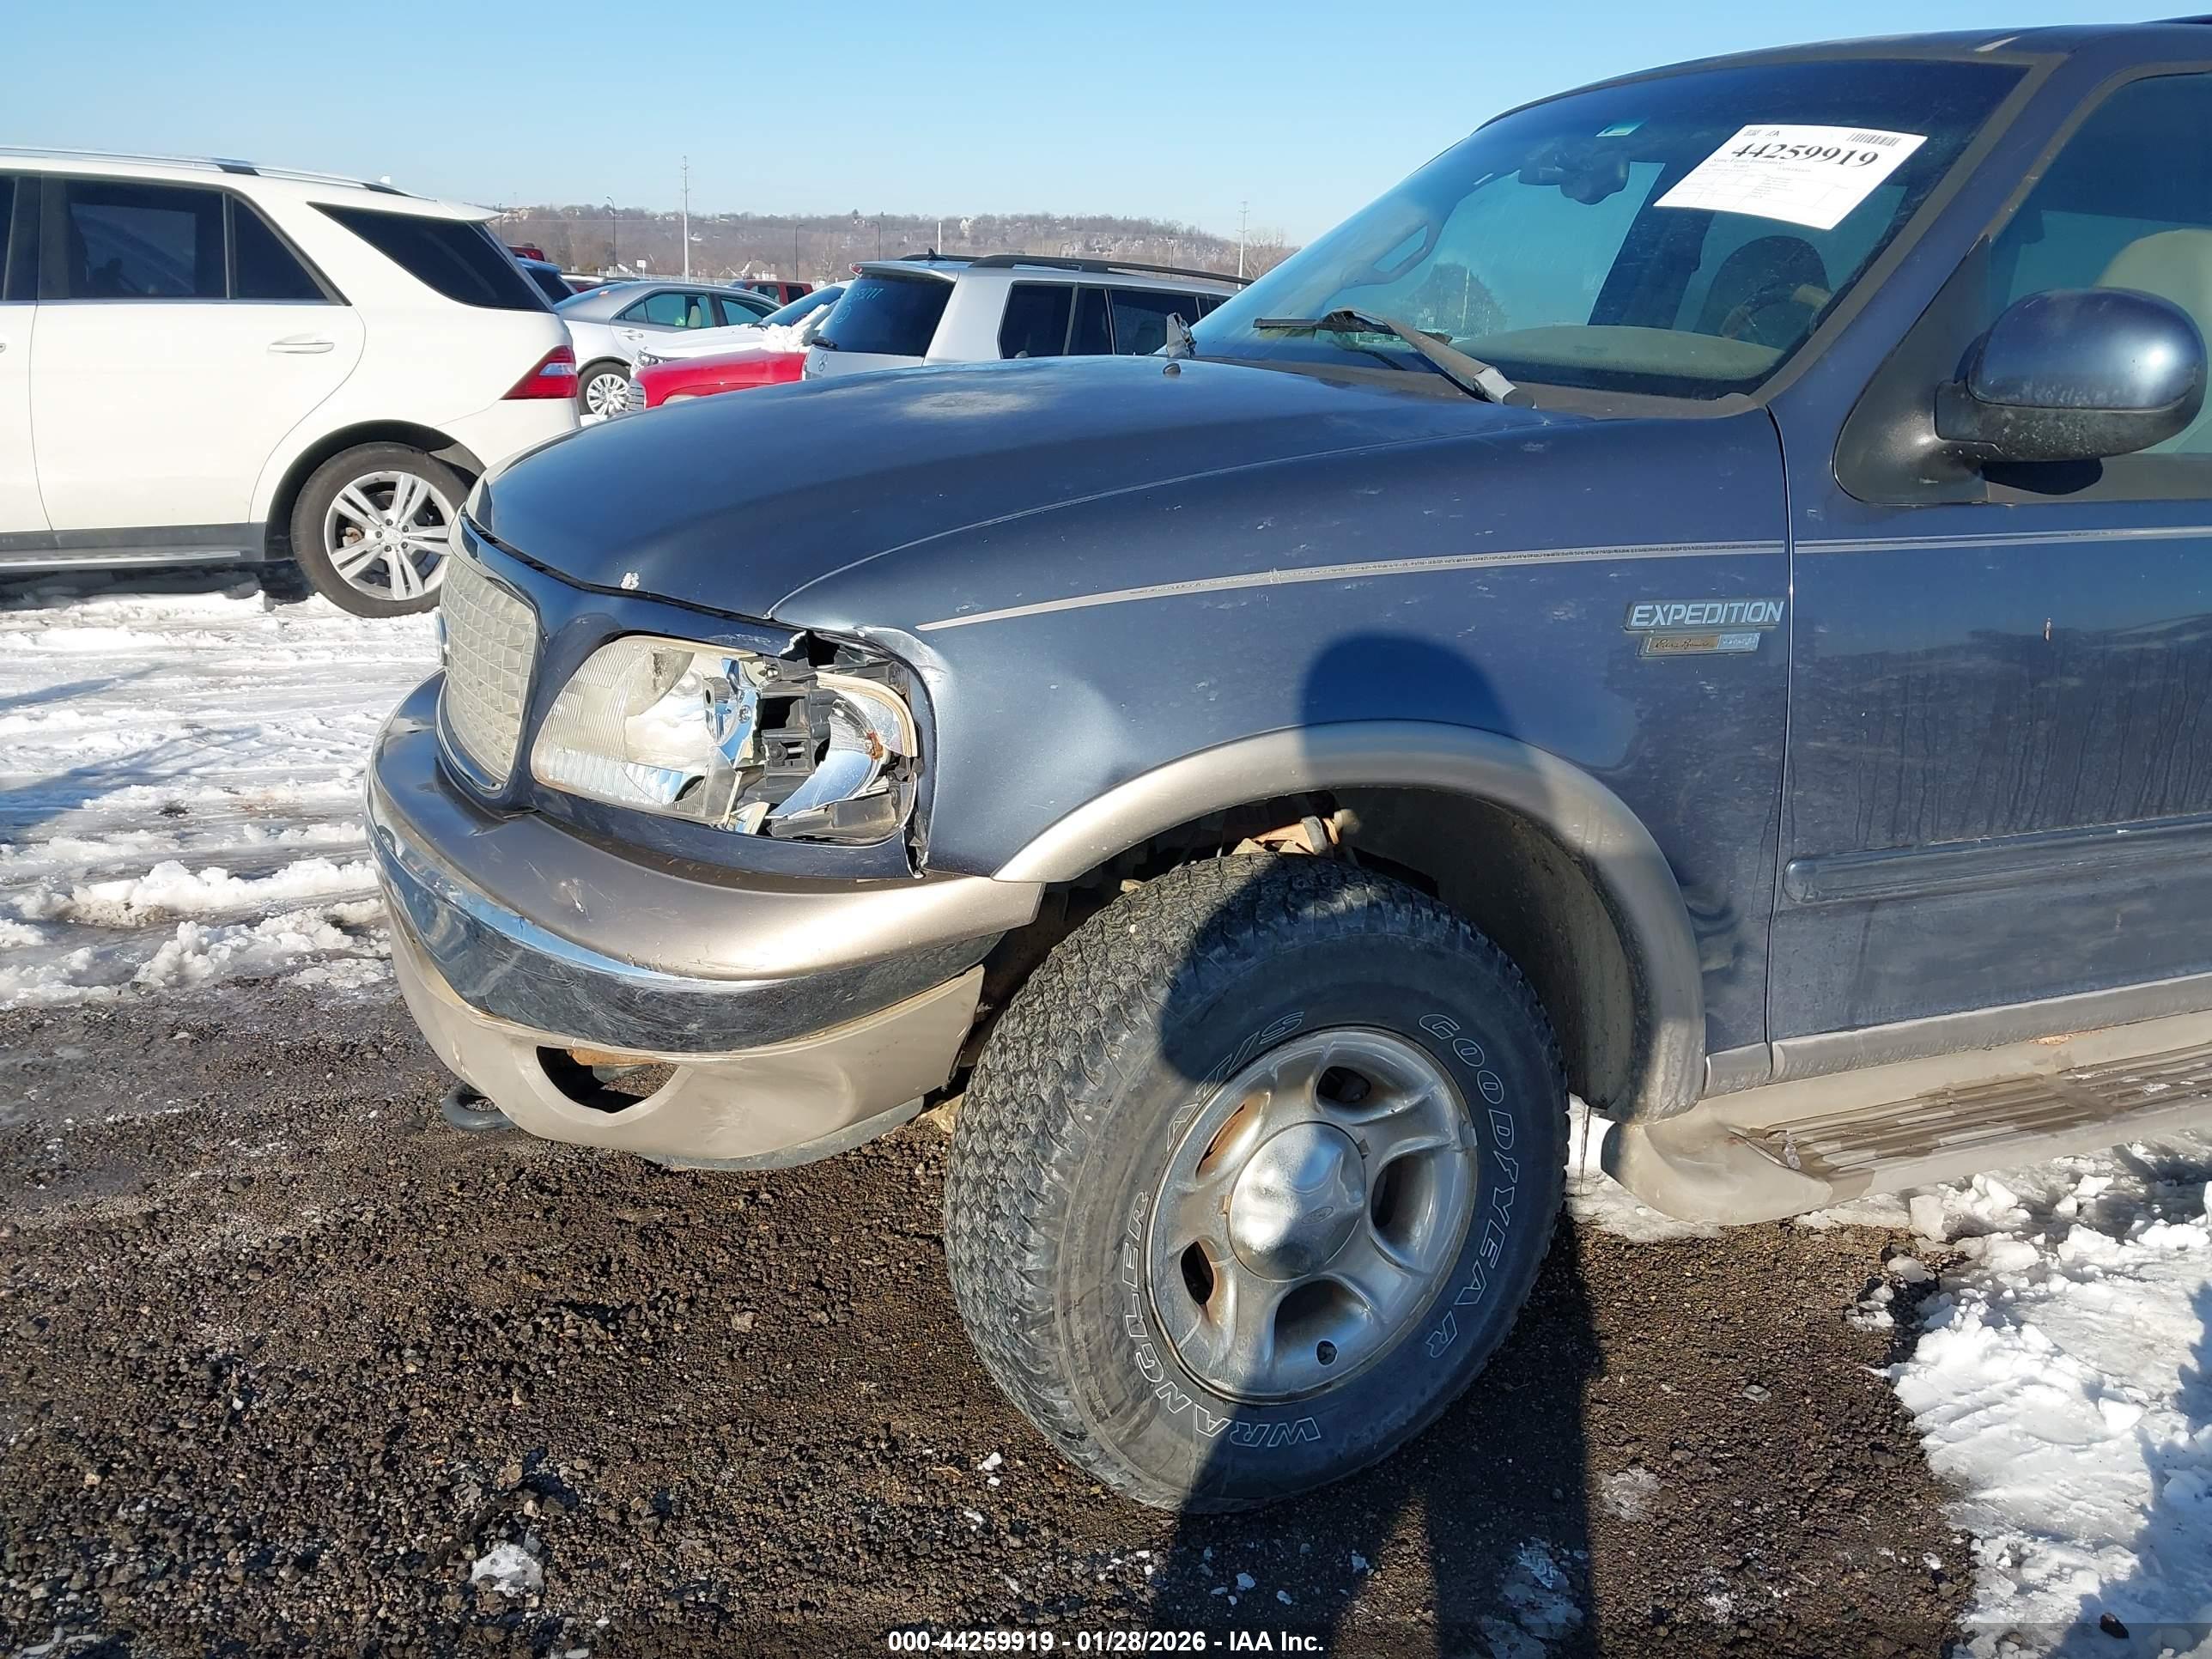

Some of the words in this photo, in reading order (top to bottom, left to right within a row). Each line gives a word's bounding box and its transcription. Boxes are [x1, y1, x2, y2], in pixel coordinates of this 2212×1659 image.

[1731, 142, 1880, 167] 44259919
[1631, 600, 1785, 627] EXPEDITION
[1419, 1012, 1520, 1358] GOODYEAR
[1121, 1190, 1322, 1449] WRANGLER
